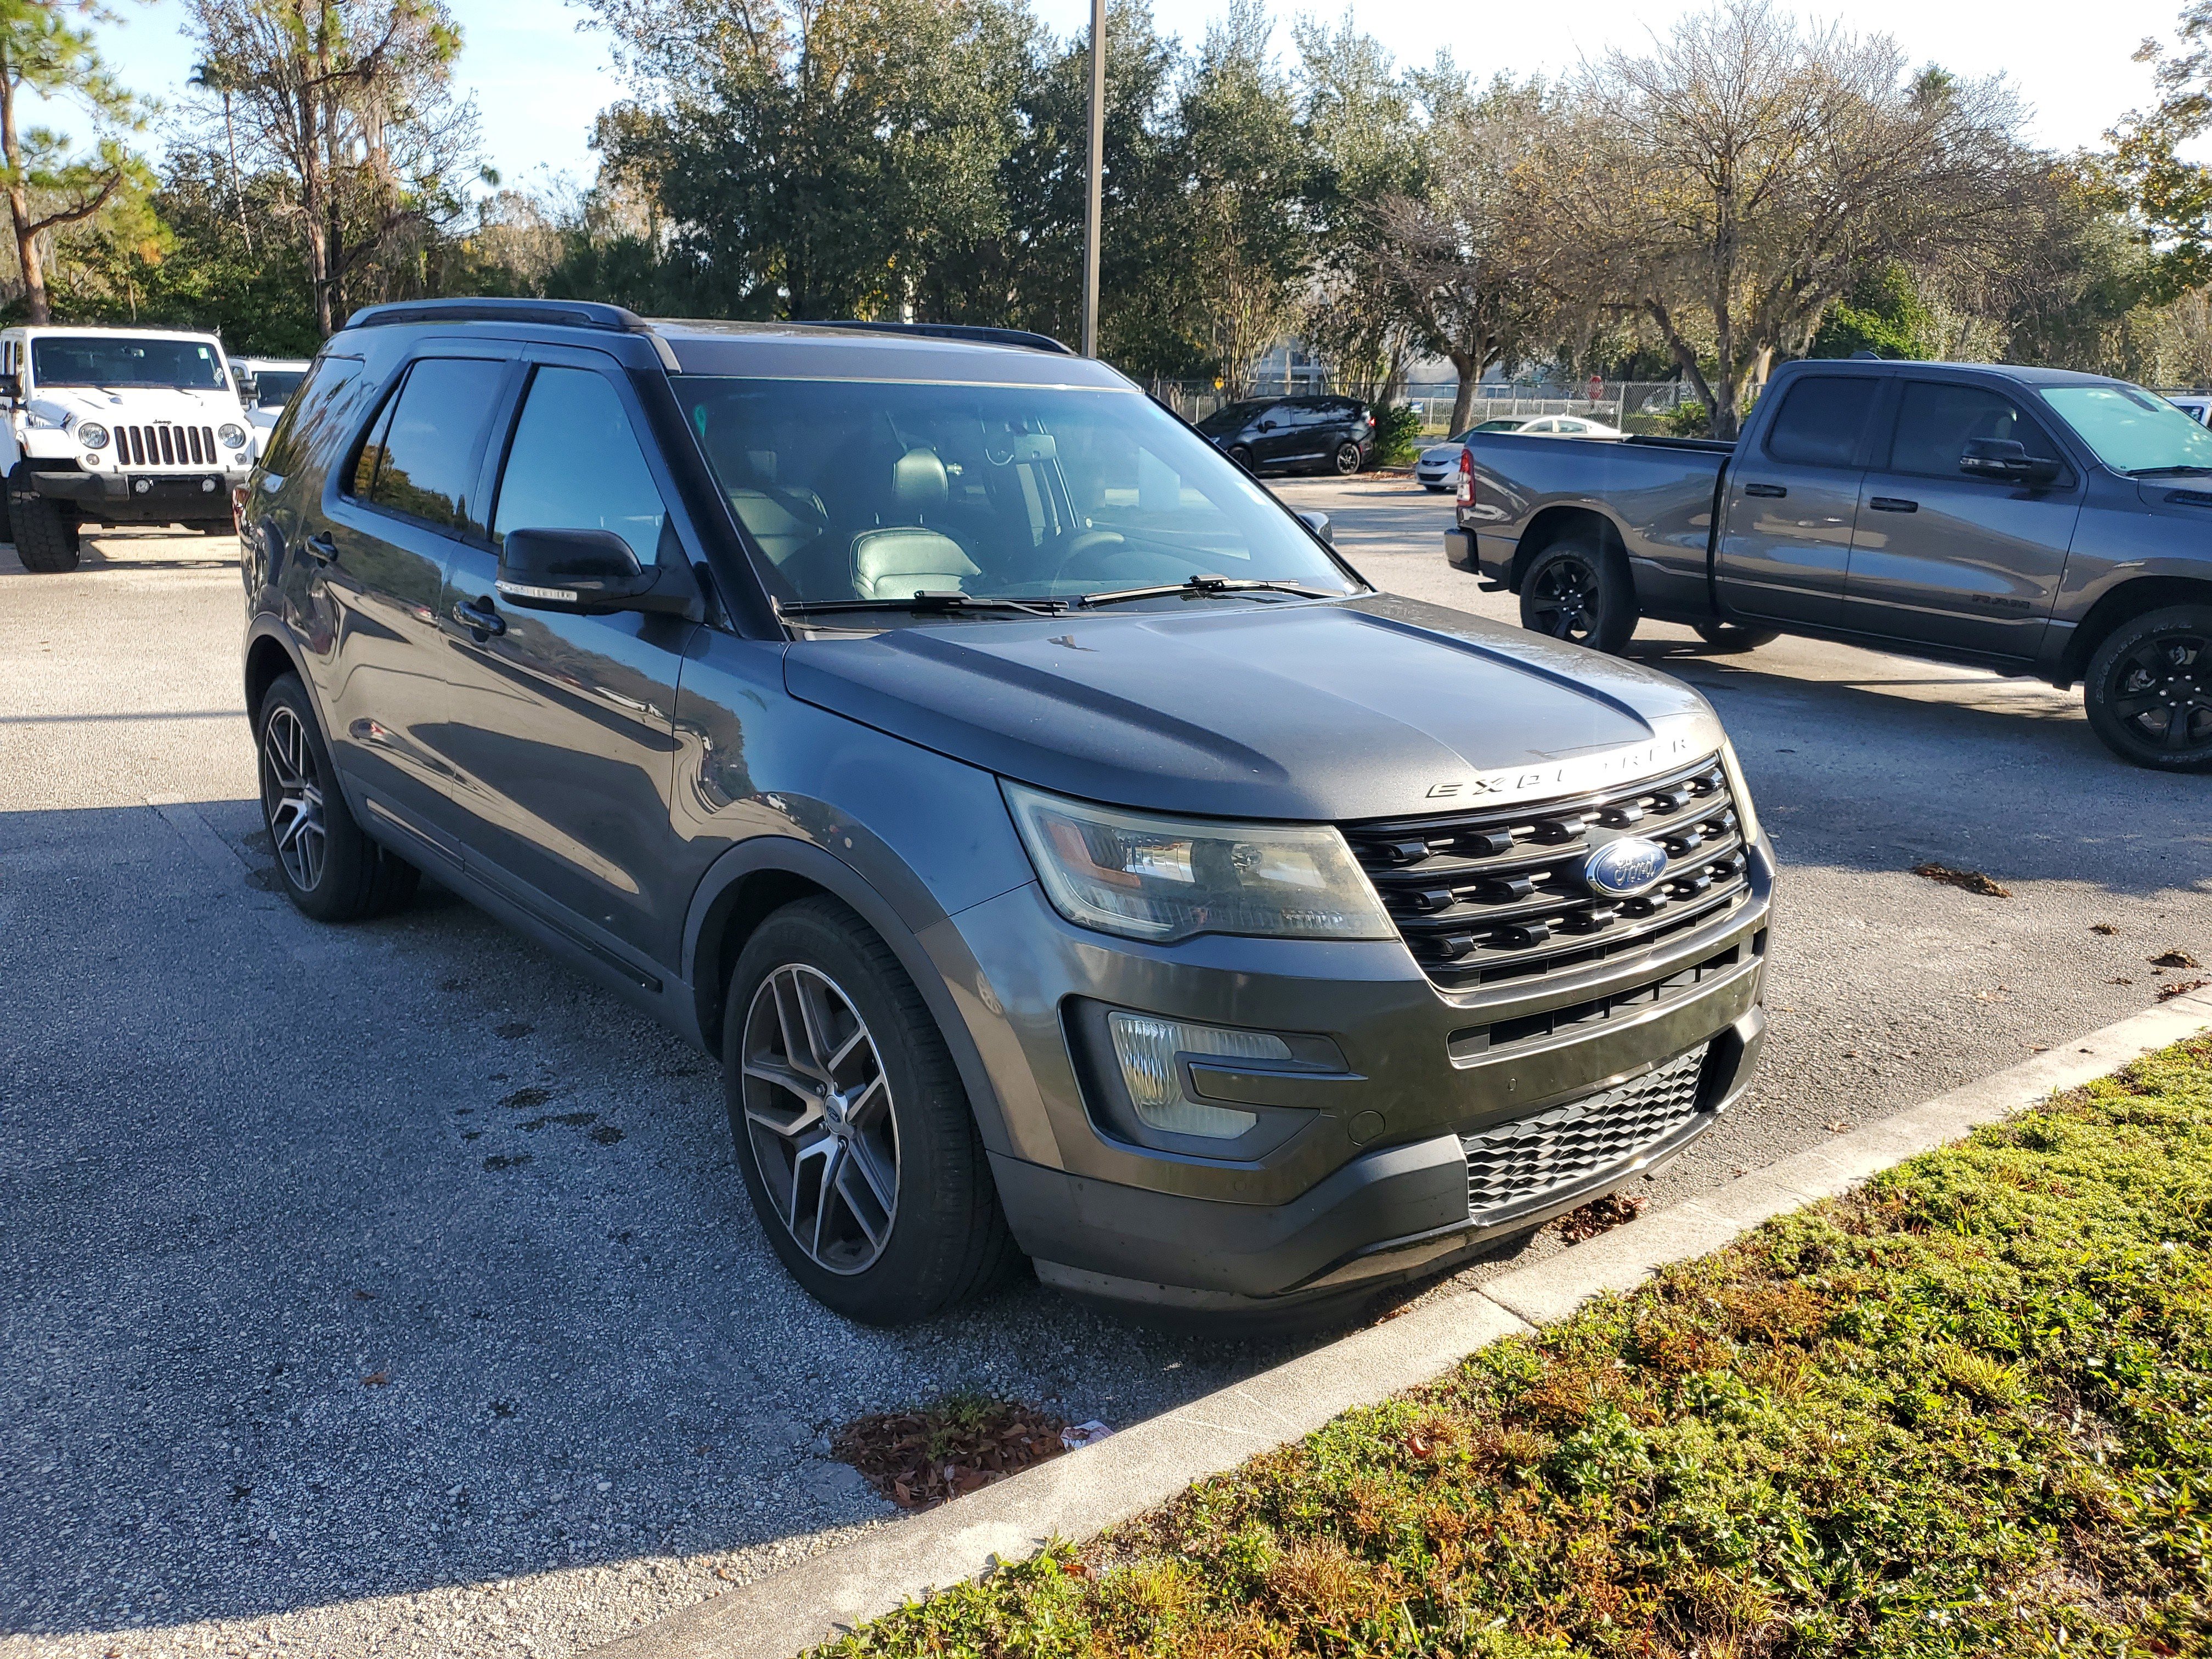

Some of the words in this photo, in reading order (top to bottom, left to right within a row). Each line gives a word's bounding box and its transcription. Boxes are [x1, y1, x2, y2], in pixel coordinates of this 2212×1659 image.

[1972, 594, 2030, 609] RAM
[1425, 739, 1686, 798] EXPLRR
[1614, 854, 1656, 886] Ford
